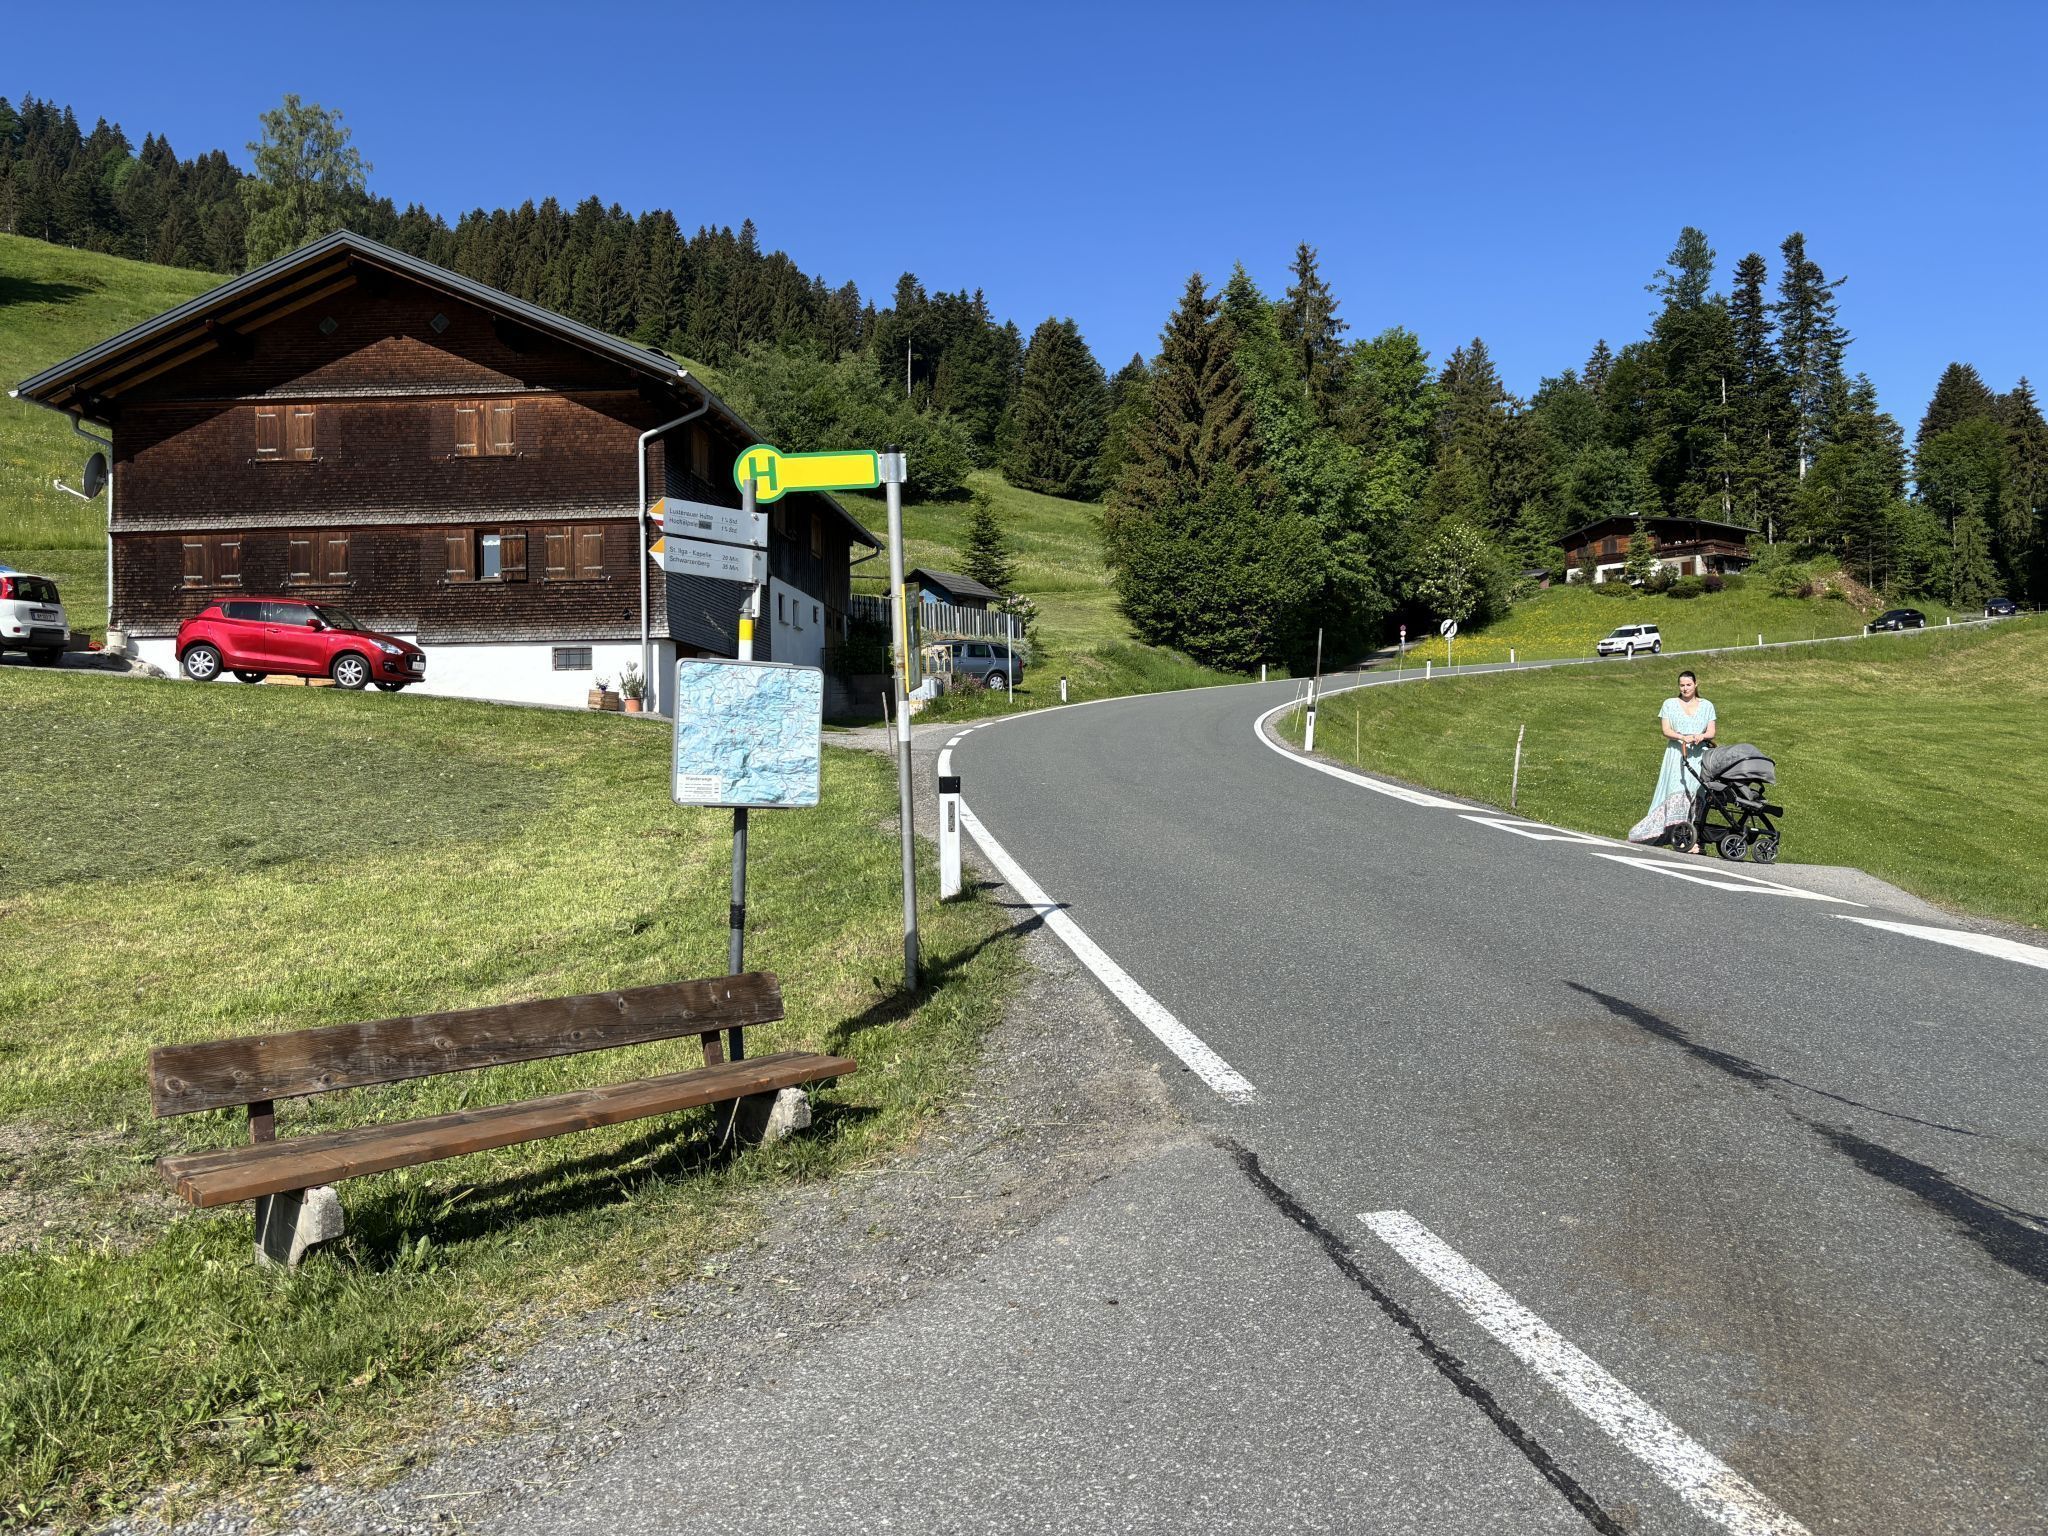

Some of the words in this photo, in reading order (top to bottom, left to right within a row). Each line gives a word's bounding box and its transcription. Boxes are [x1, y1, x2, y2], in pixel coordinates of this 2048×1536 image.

[748, 456, 778, 491] H
[669, 507, 698, 518] Lustenauer
[693, 550, 712, 558] Kapelle
[669, 555, 710, 568] Schwarzenberg
